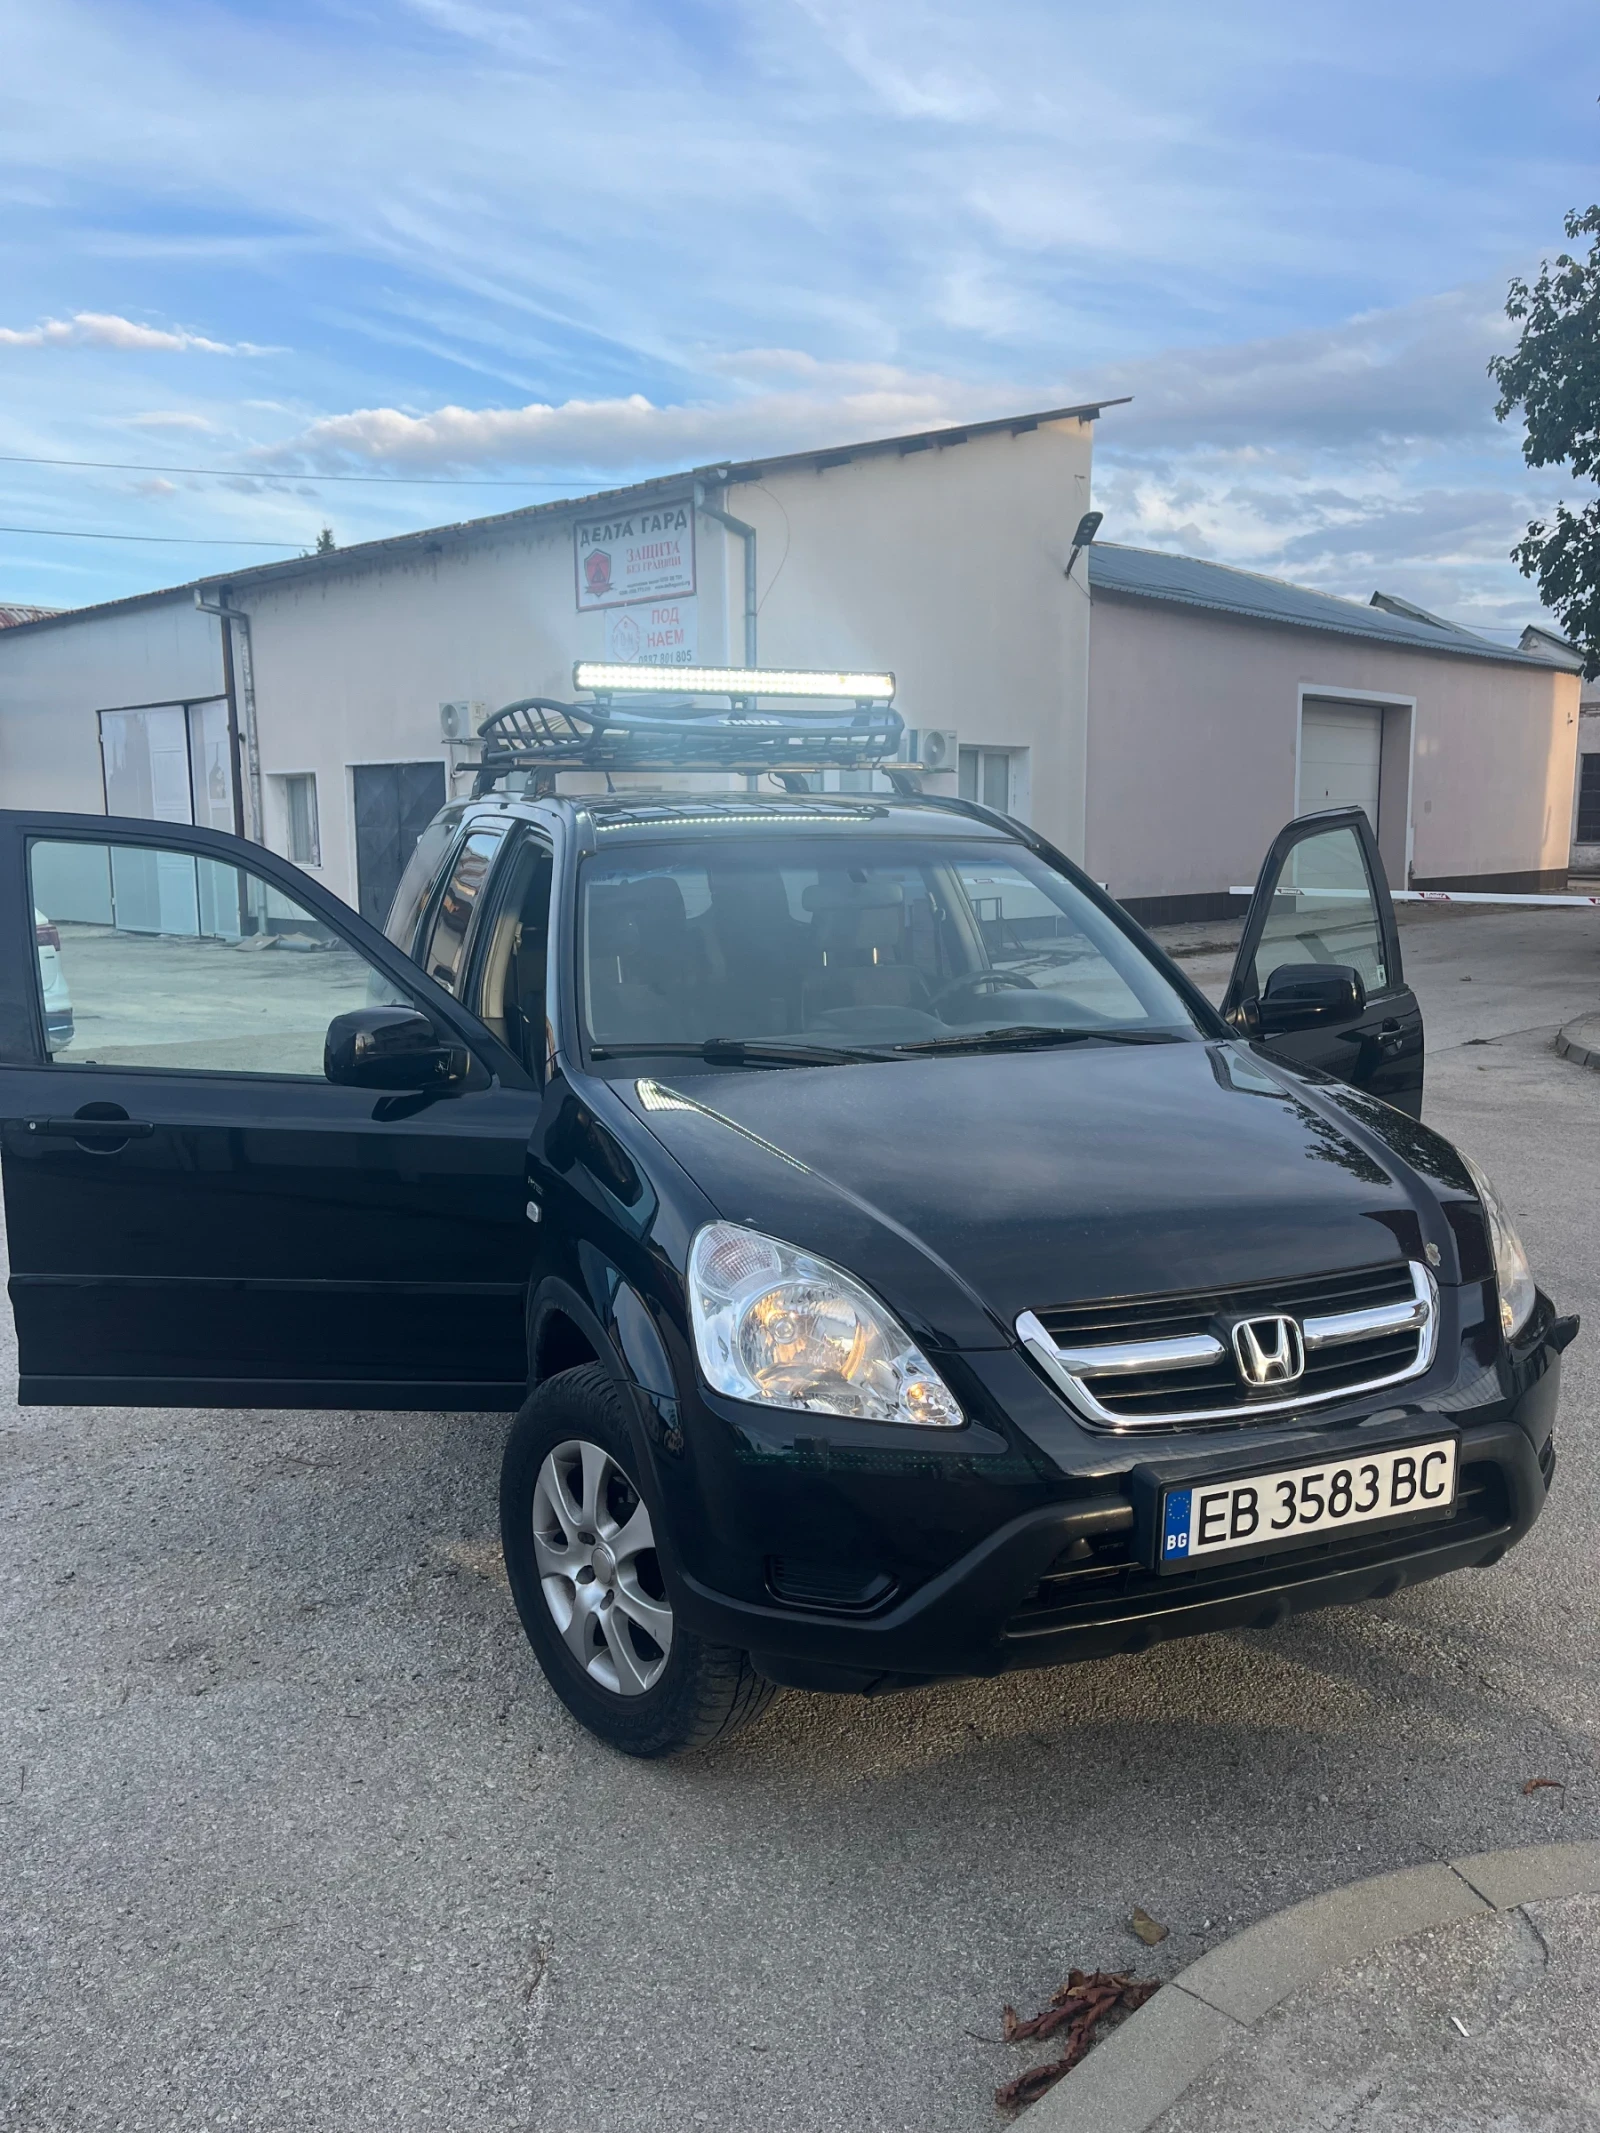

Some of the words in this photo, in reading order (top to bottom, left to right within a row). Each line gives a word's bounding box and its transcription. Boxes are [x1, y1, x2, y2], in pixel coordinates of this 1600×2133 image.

[580, 520, 634, 548] ДЕЛТА
[641, 509, 688, 534] ГАРД
[626, 540, 681, 563] ЗАЩИТА
[626, 563, 641, 575] БЕЗ
[642, 556, 681, 572] ГРАНИЦИ
[652, 606, 680, 625] ПОД
[647, 628, 684, 648] НАЕМ
[660, 652, 674, 664] 801
[676, 649, 692, 662] 805
[1197, 1487, 1260, 1546] EB
[1270, 1464, 1380, 1530] 3583
[1390, 1450, 1448, 1507] BC
[1166, 1533, 1188, 1551] BG
